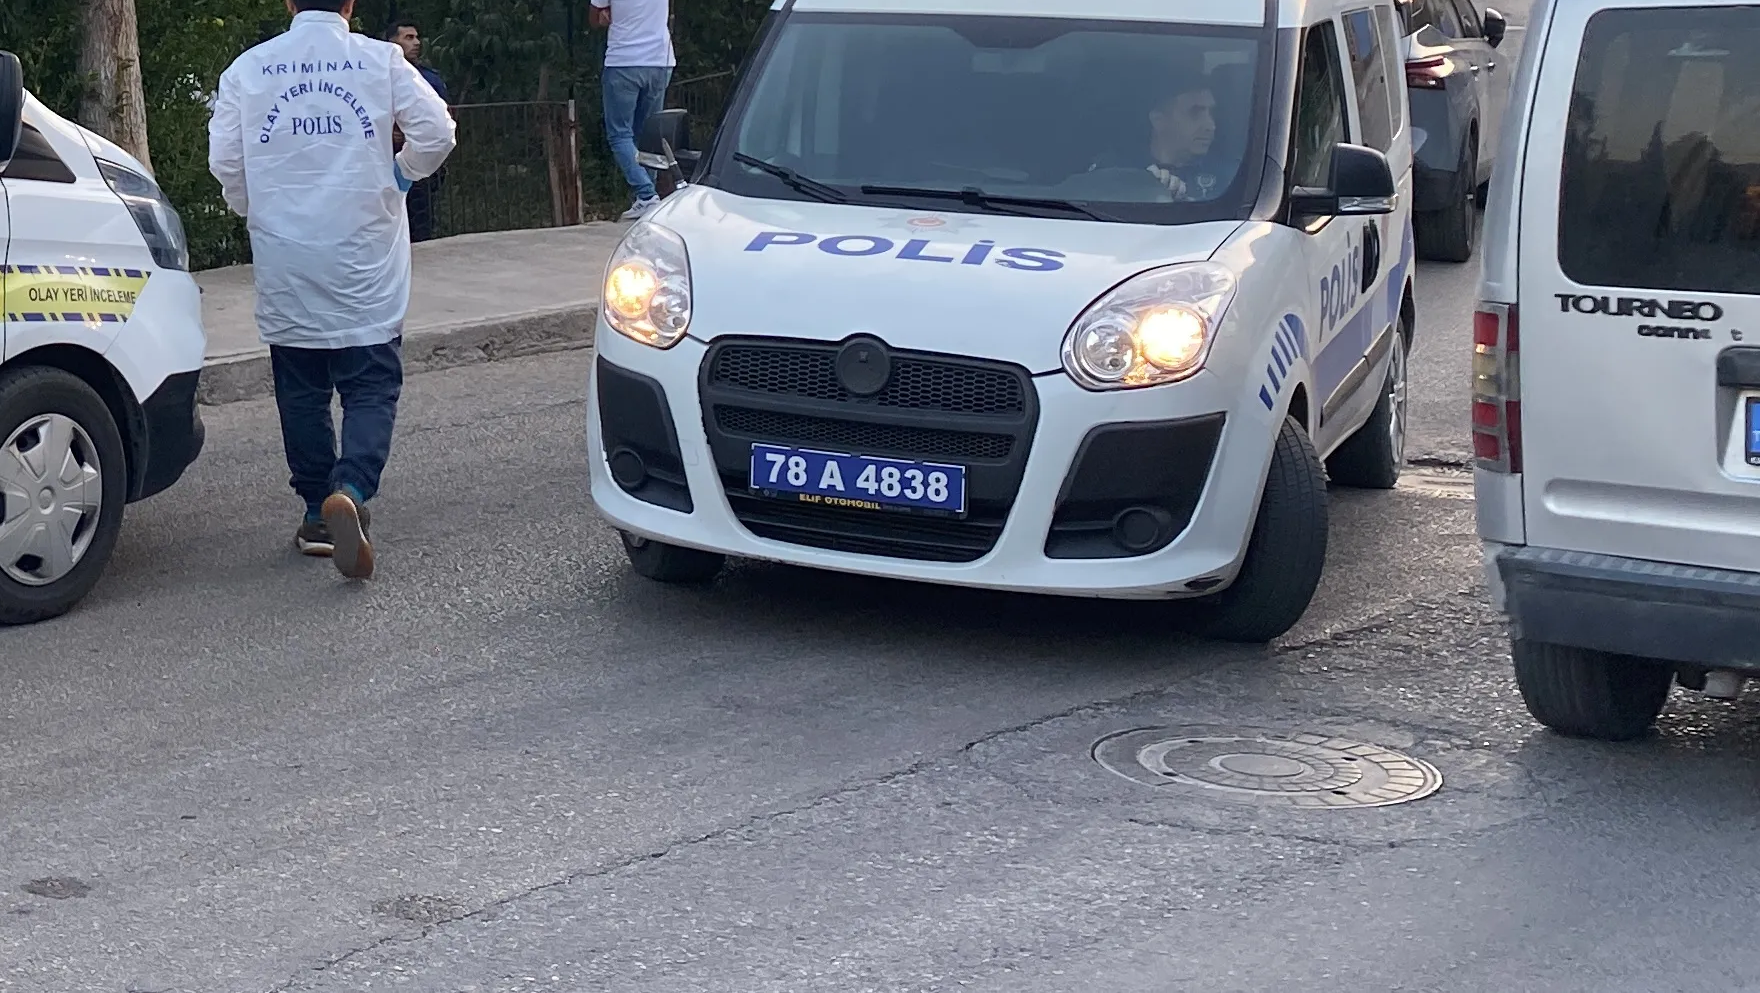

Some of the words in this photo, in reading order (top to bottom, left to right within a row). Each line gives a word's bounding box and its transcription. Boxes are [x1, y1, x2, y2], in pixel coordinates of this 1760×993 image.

[263, 61, 366, 75] KRİMİNAL
[261, 103, 281, 143] OLAY
[280, 79, 314, 103] YERİ
[318, 79, 375, 140] İNCELEME
[292, 111, 342, 135] POLİS
[743, 231, 1067, 272] POLİS
[28, 287, 59, 302] OLAY
[62, 285, 87, 302] YERİ
[90, 285, 136, 304] İNCELEME
[1319, 230, 1359, 343] POLİS
[1554, 293, 1724, 322] TOURNEO
[765, 453, 807, 487] 78
[818, 460, 845, 492] A
[856, 464, 949, 503] 4838
